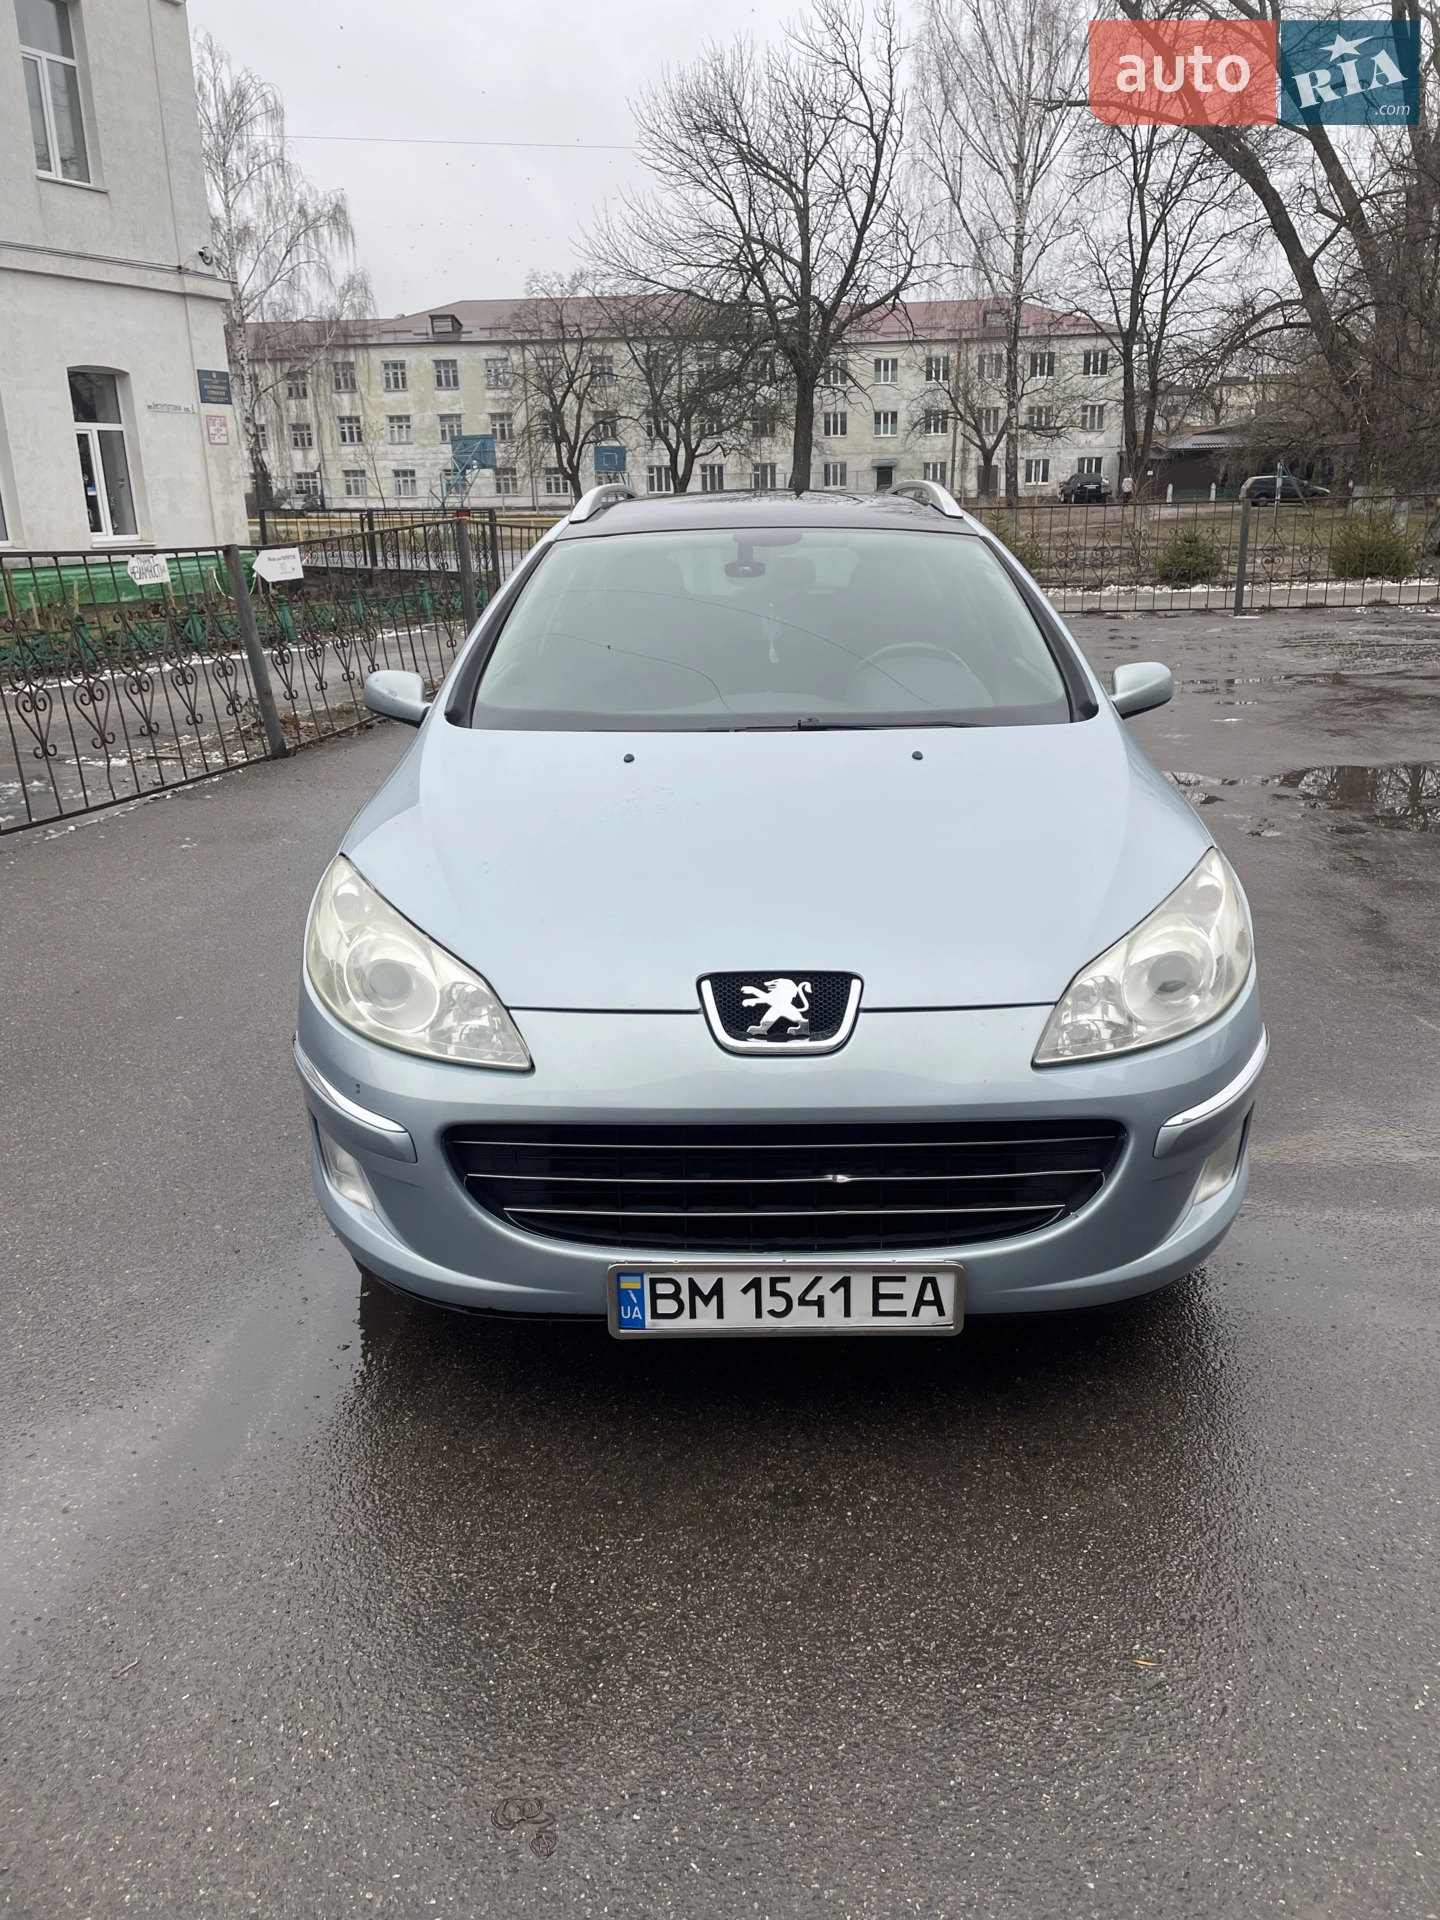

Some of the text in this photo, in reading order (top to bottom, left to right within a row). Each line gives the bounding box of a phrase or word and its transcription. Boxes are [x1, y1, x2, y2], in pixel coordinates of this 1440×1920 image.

[621, 1305, 643, 1320] UA
[649, 1275, 946, 1320] BM 1541 EA
